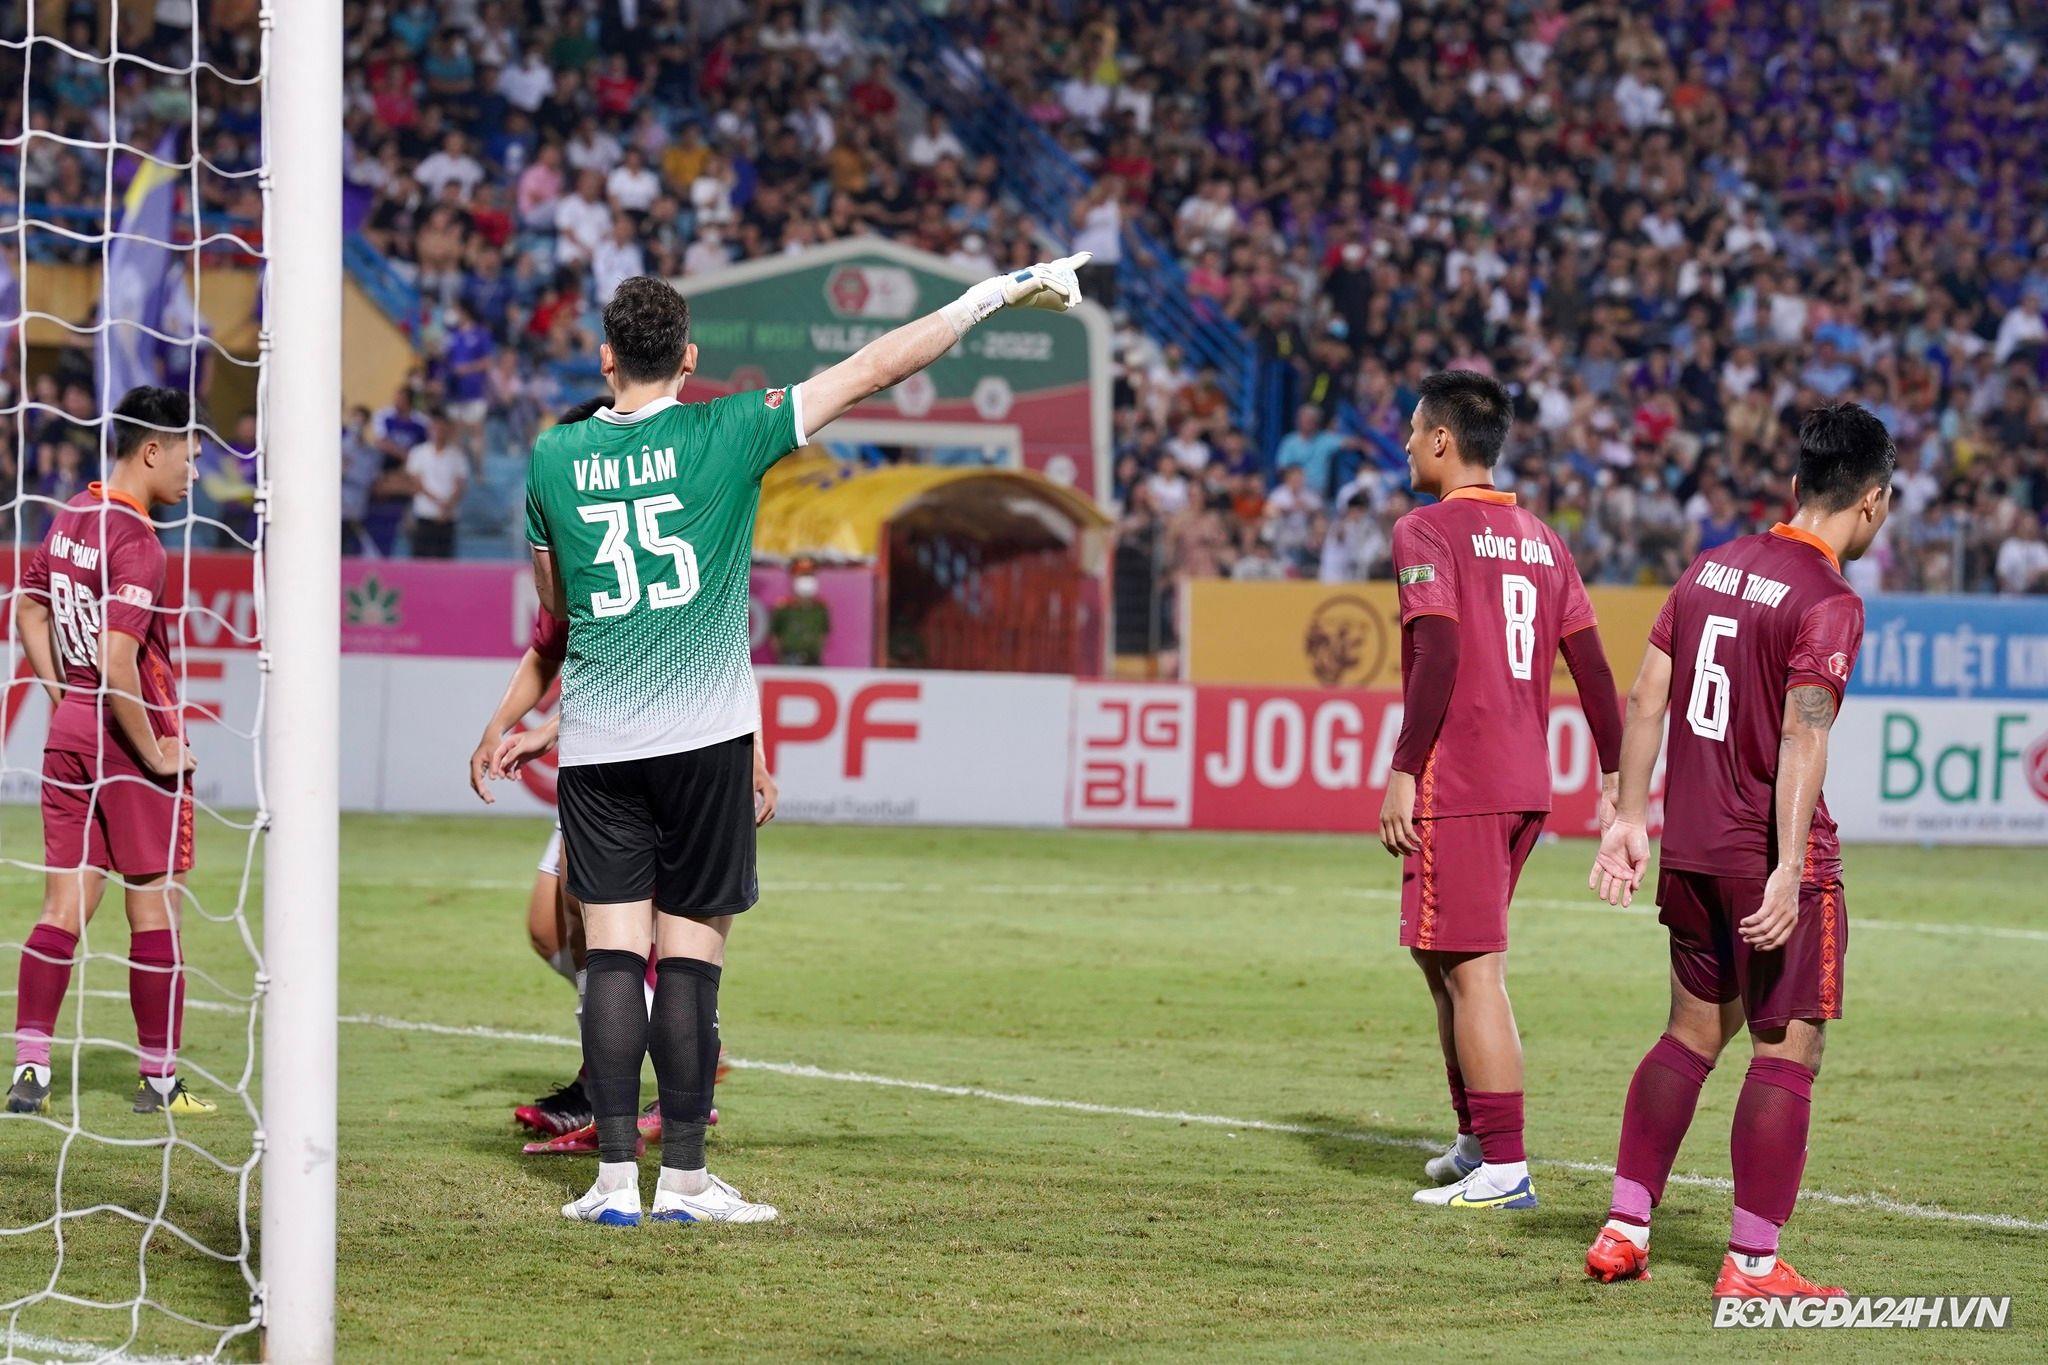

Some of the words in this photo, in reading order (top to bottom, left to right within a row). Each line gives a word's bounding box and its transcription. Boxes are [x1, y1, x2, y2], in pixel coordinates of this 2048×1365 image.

[573, 452, 620, 491] VĂN
[626, 445, 677, 486] LÂM
[576, 493, 700, 618] 35
[1471, 526, 1517, 560] HỒNG
[1502, 574, 1537, 680] 8
[1686, 614, 1738, 742] 6
[762, 679, 921, 778] PF
[1083, 760, 1178, 810] BL
